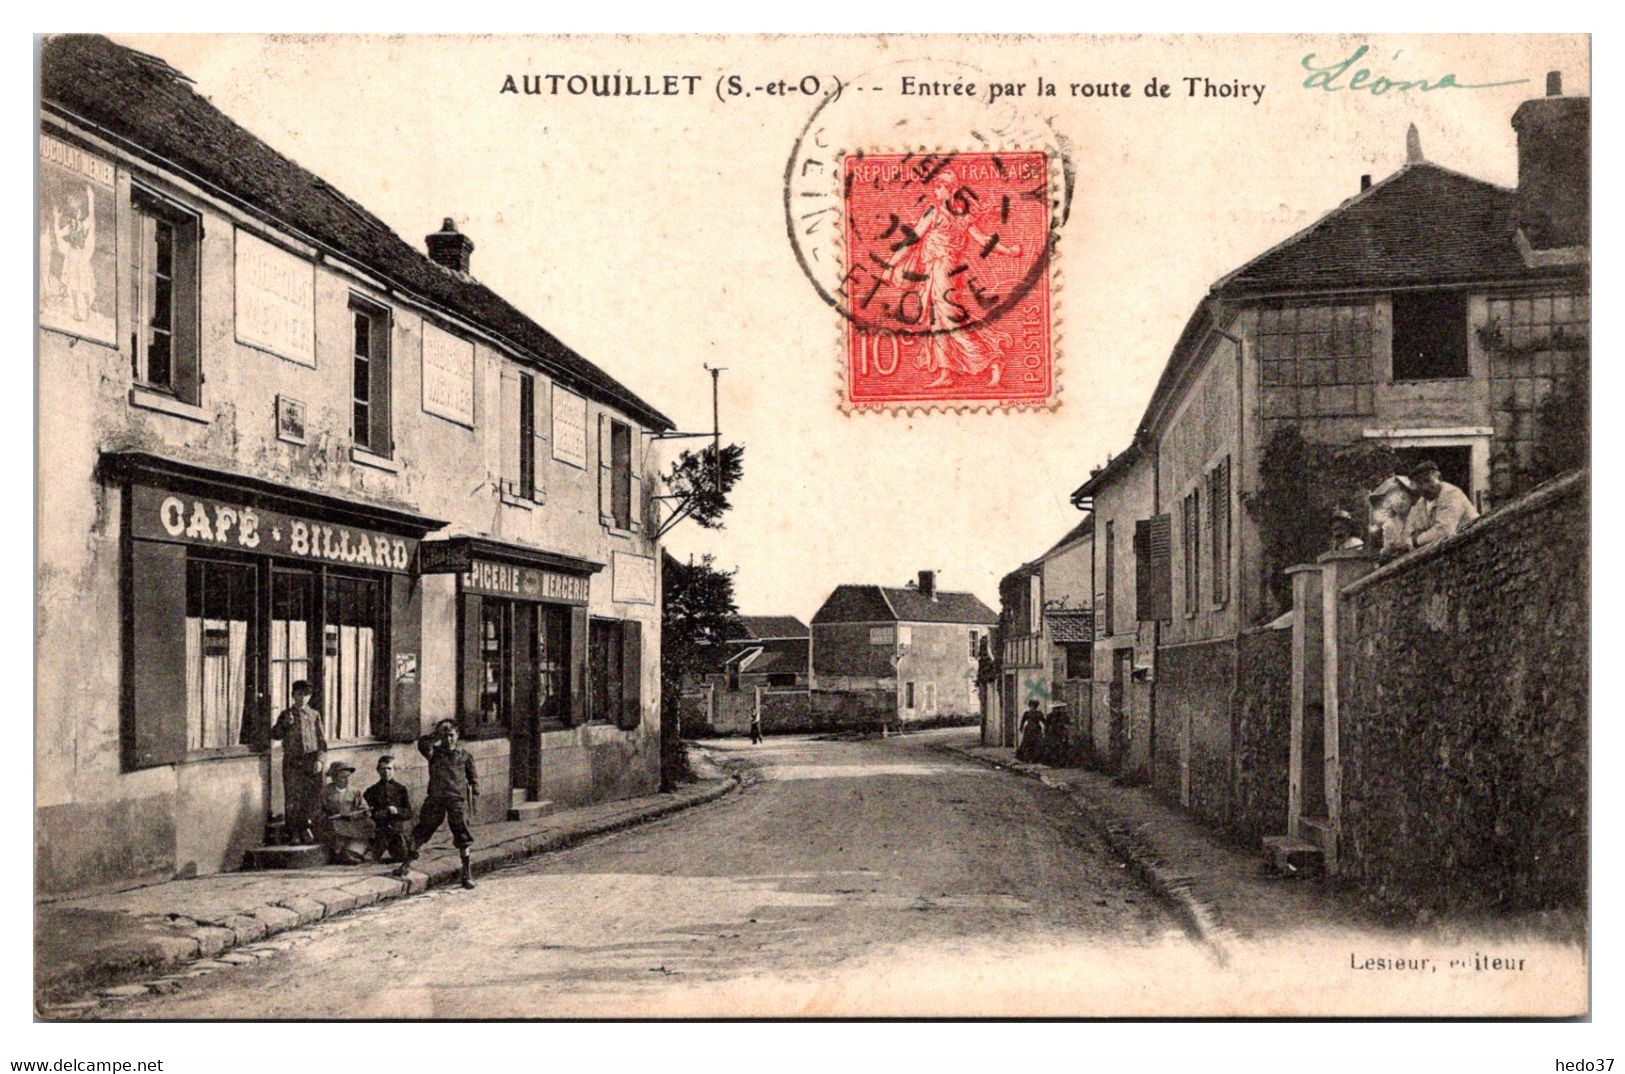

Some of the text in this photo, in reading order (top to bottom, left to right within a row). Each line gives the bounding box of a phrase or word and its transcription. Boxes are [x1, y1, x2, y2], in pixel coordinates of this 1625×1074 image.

[1301, 45, 1530, 95] Léona
[1023, 303, 1041, 383] POSTES
[160, 496, 260, 549] CAFÉ
[290, 519, 409, 570] BILLARD
[463, 558, 590, 601] EPICERIE MERCERIE
